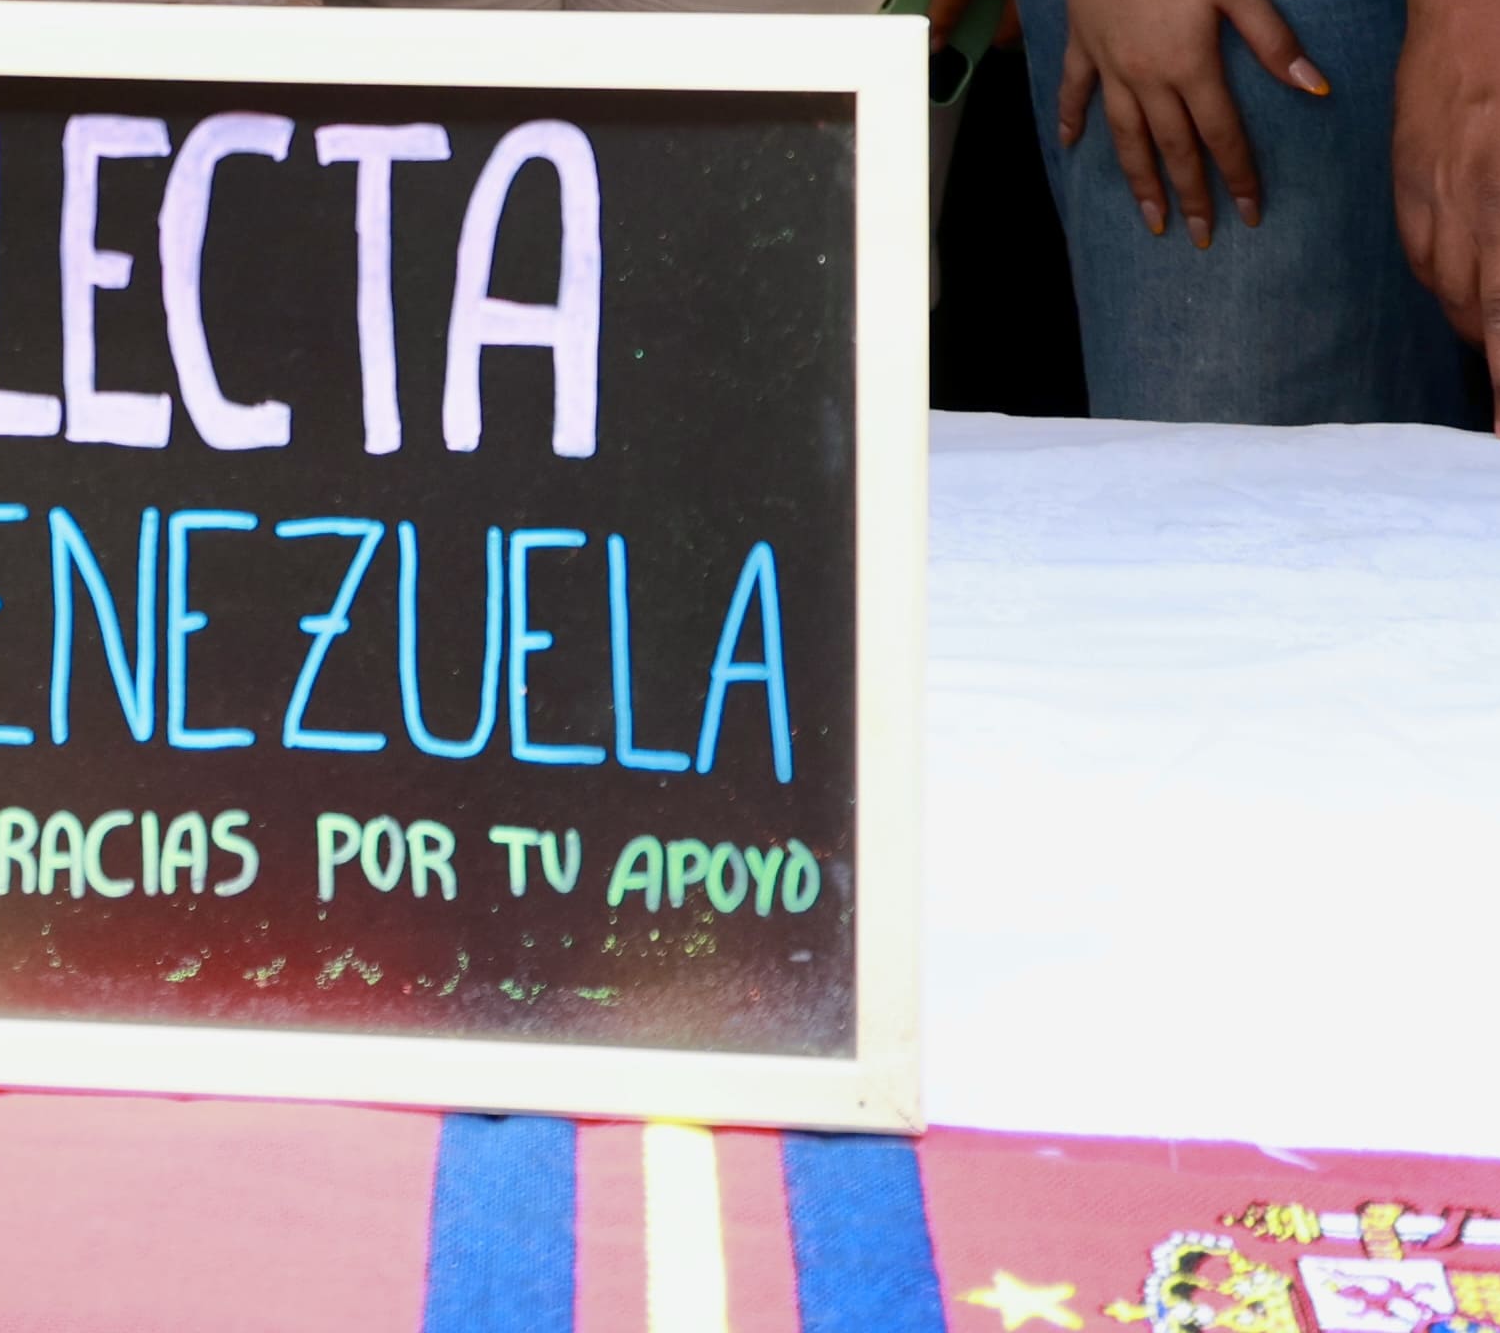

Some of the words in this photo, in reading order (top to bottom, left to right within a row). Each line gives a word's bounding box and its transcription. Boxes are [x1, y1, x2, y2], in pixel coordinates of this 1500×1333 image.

[318, 811, 458, 901] POR
[489, 825, 583, 895] TU
[608, 834, 823, 916] APOYO
